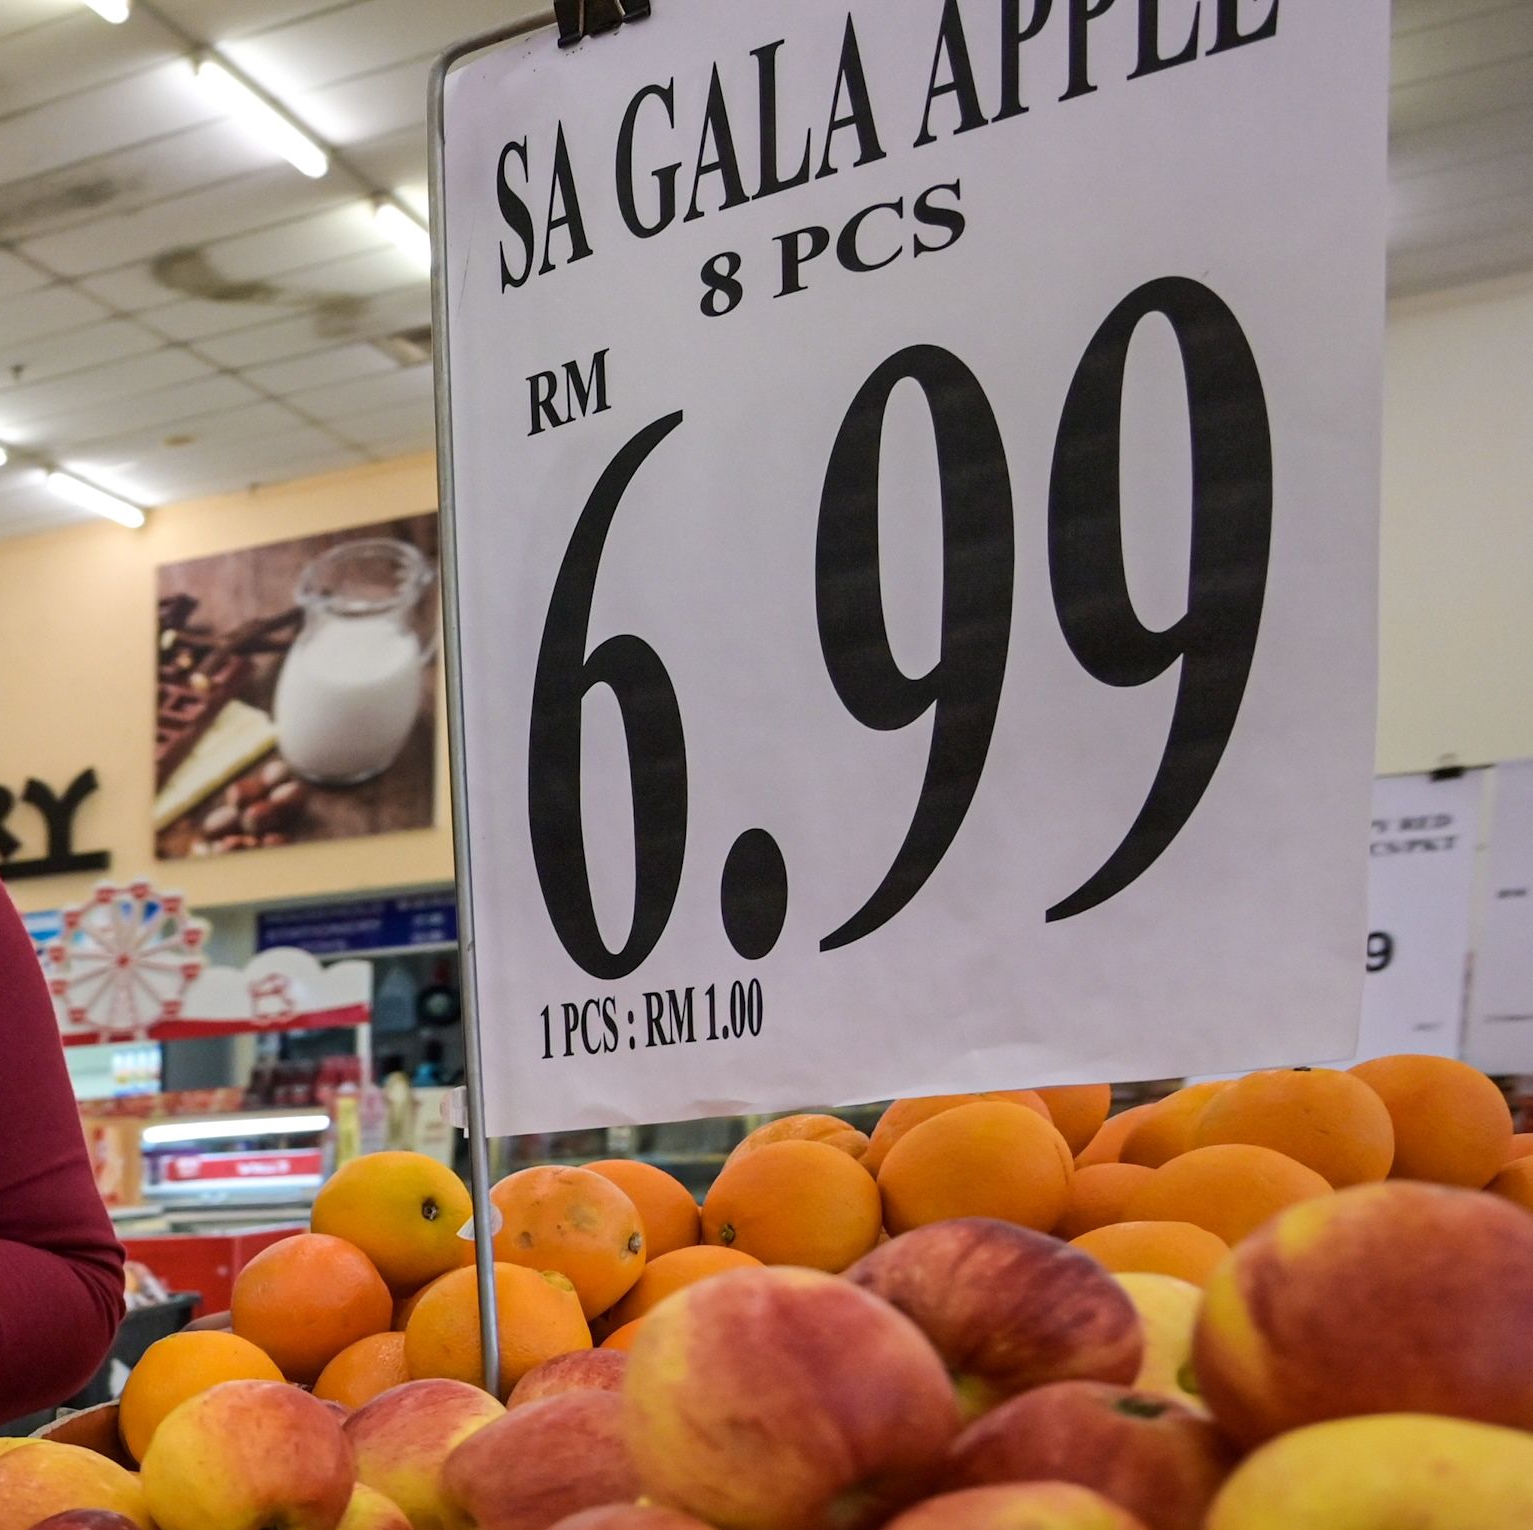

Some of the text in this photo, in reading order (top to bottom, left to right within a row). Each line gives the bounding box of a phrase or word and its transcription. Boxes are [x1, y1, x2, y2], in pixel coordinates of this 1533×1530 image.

[496, 120, 594, 294] SA
[615, 12, 887, 239] GALA
[700, 178, 966, 317] 8 PCS
[526, 347, 612, 436] RM
[527, 275, 1273, 980] 6.99
[540, 1004, 554, 1059] 1
[561, 996, 619, 1056] PCS
[643, 986, 696, 1047] RM
[705, 978, 763, 1041] 1.00
